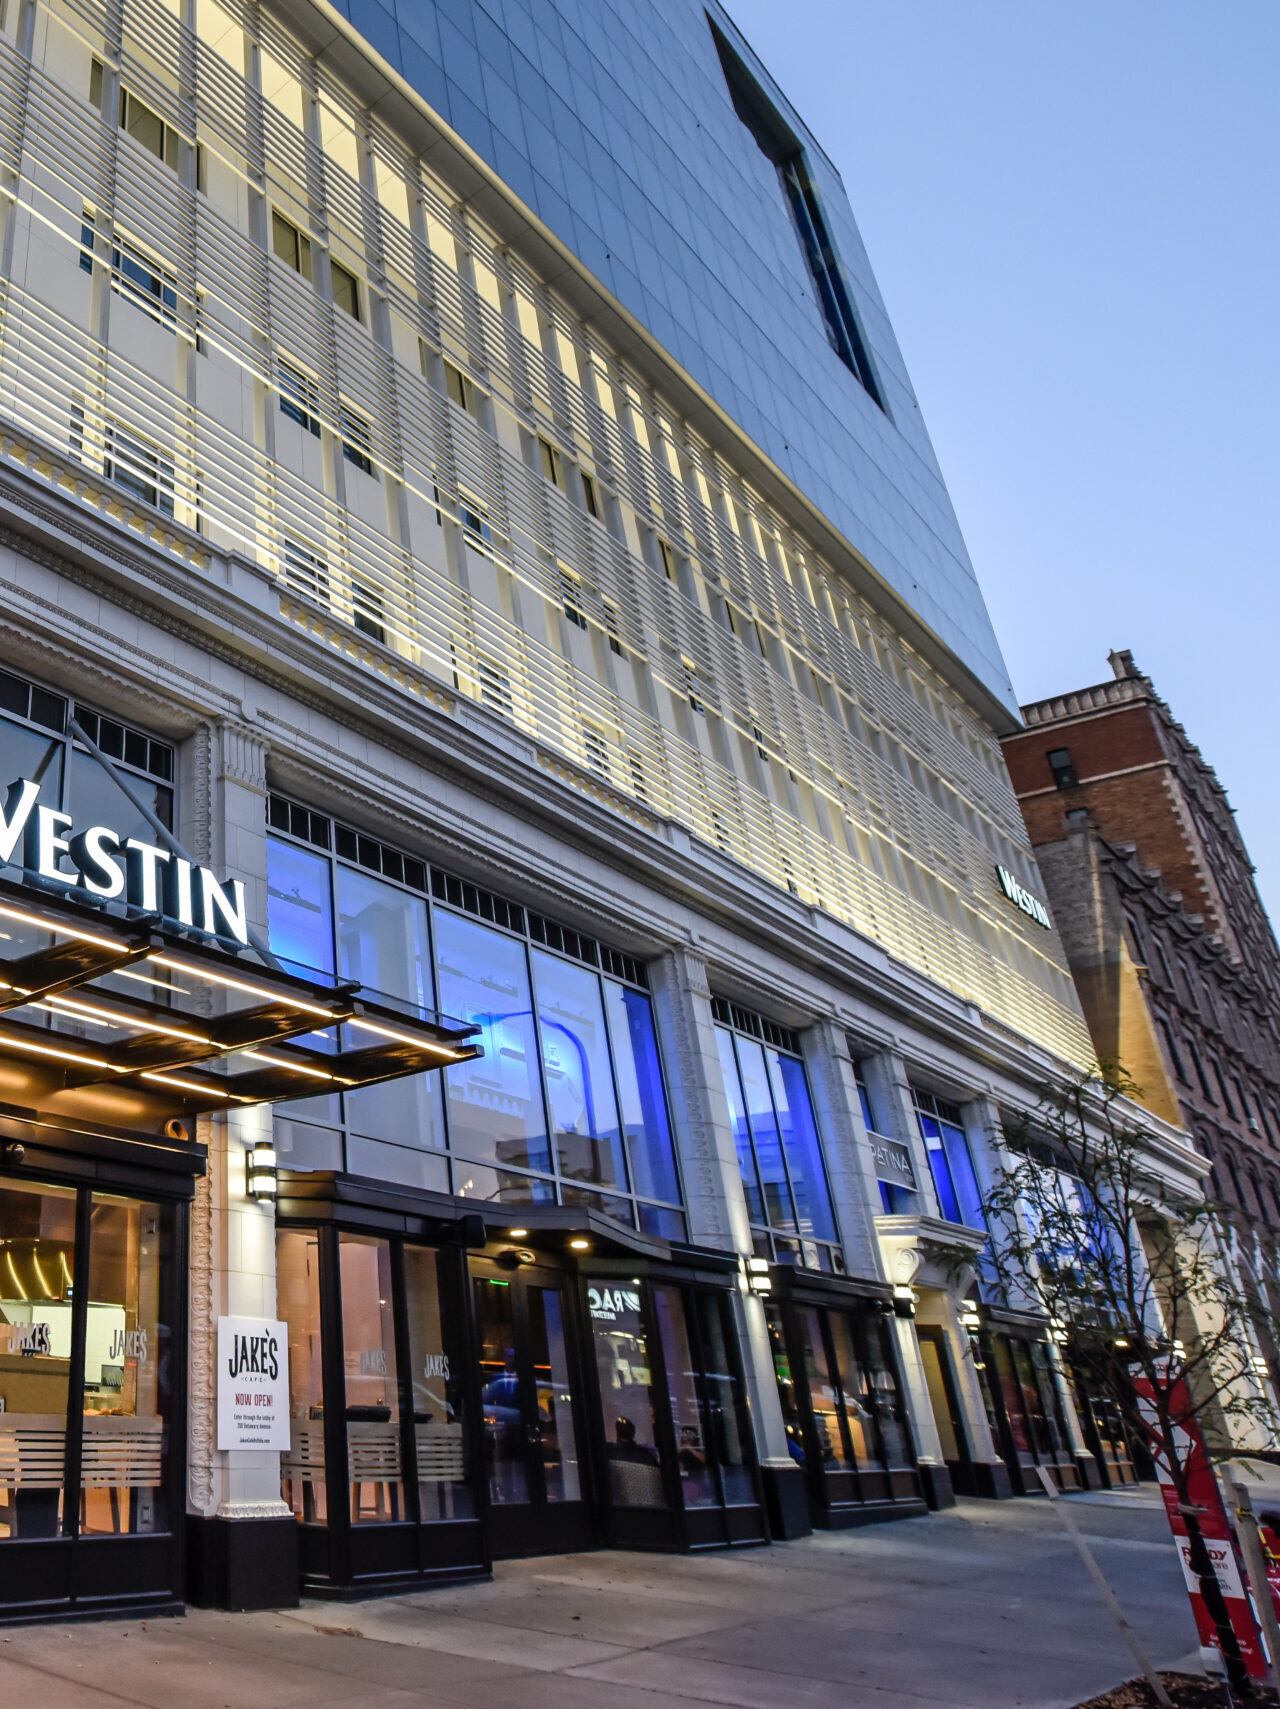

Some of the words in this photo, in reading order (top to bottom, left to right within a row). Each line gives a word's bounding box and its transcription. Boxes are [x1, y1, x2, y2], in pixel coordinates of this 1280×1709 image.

[996, 864, 1052, 930] WESTIN
[228, 1328, 279, 1381] JAKE'S
[235, 1393, 252, 1406] NOW
[254, 1394, 273, 1407] OPEN!
[1181, 1546, 1228, 1560] RDY
